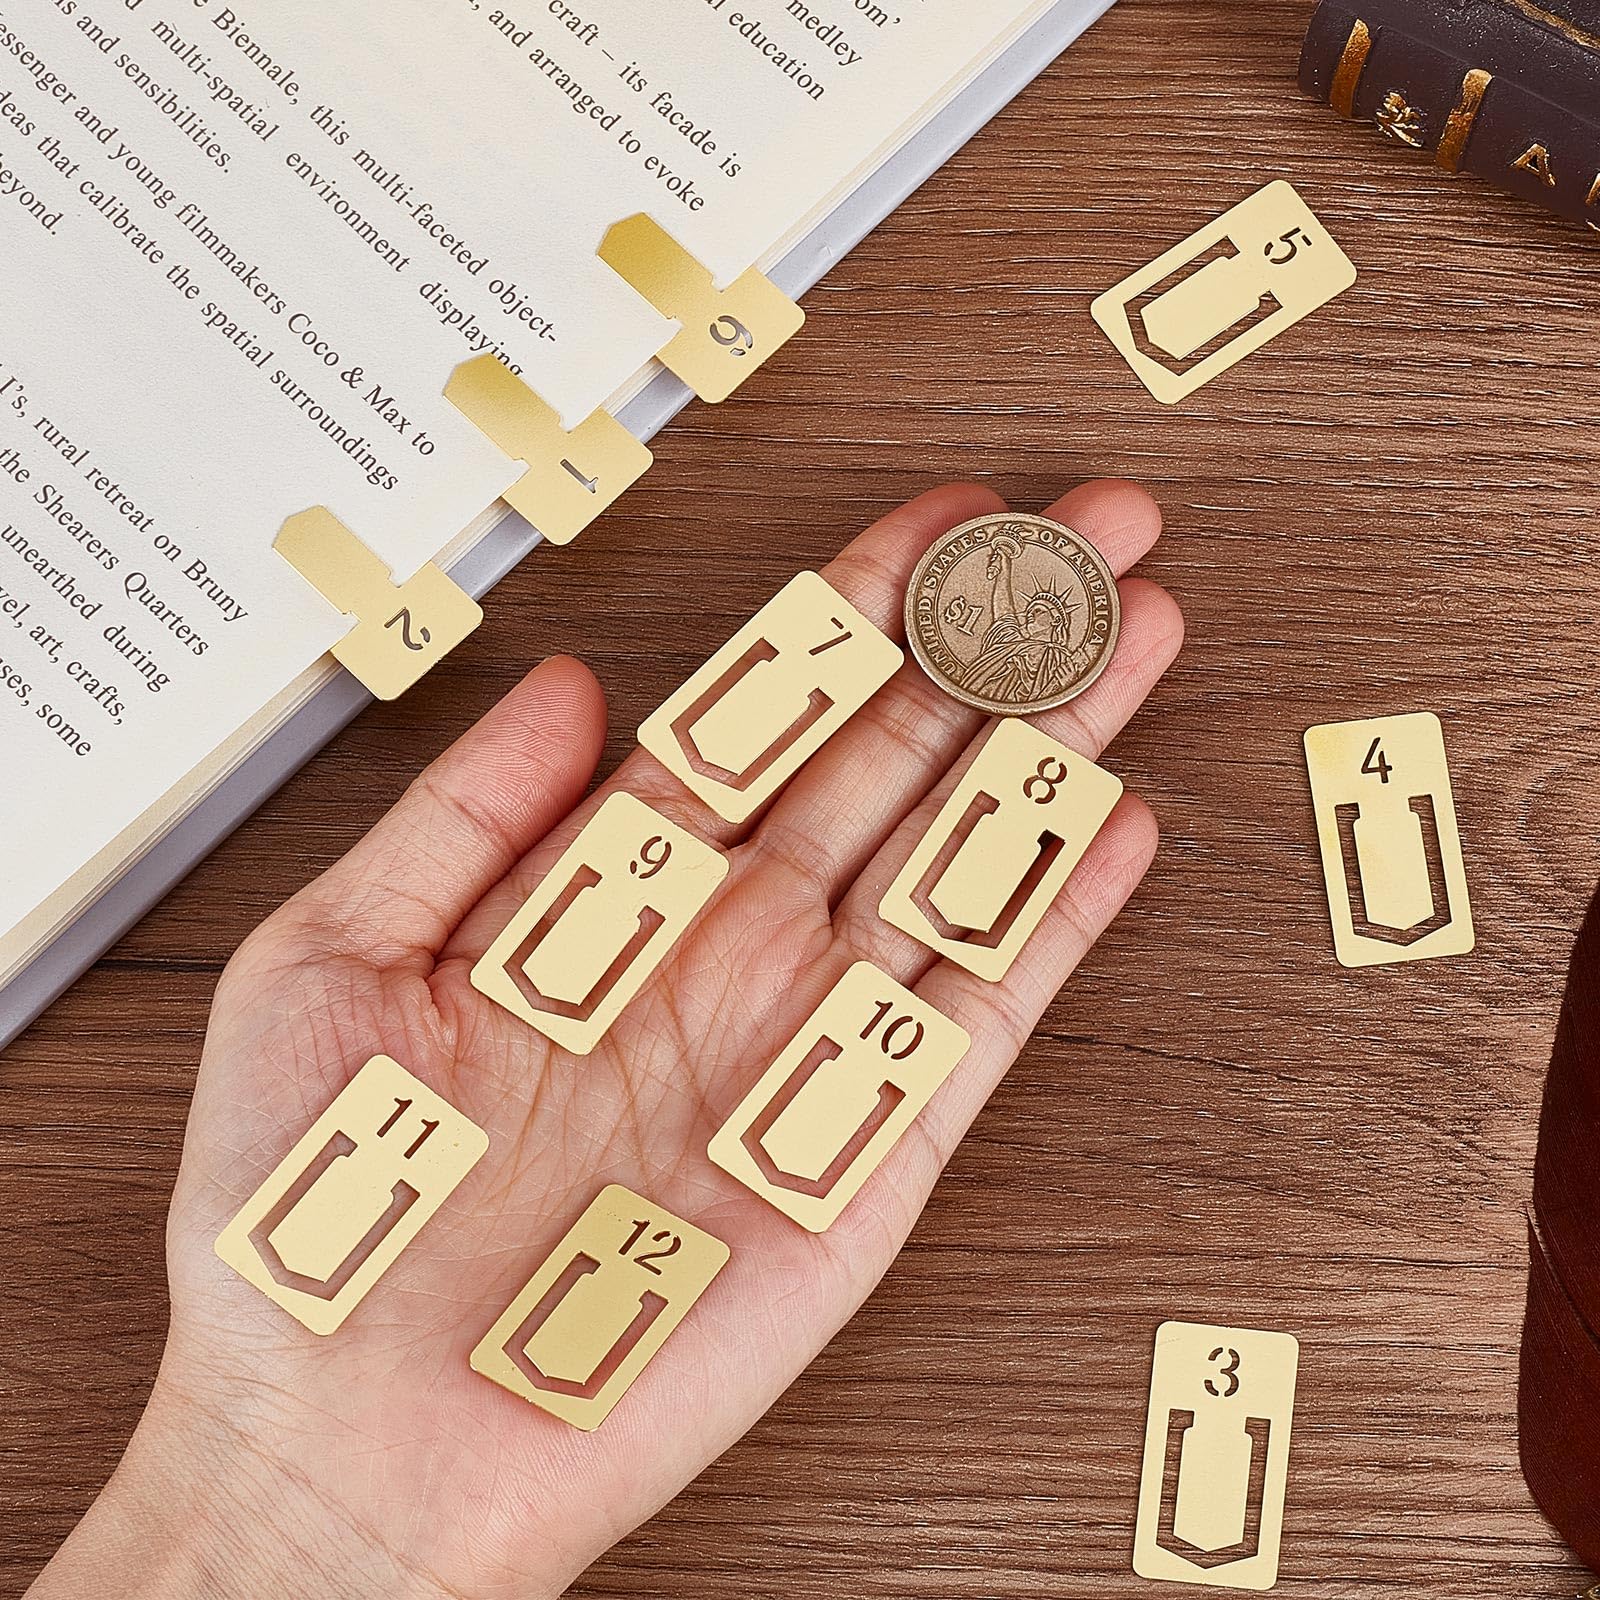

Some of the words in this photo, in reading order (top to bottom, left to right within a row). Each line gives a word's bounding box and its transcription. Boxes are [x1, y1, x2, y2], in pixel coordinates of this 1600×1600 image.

[729, 13, 824, 100] education
[786, 0, 862, 65] medley
[77, 16, 120, 53] and
[114, 54, 230, 173] sensibilities.
[489, 10, 533, 47] and
[529, 49, 621, 131] arranged
[619, 130, 640, 153] to
[645, 157, 704, 210] evoke
[548, 0, 599, 45] craft
[619, 62, 647, 92] its
[649, 92, 716, 154] facade
[719, 153, 741, 177] is
[151, 21, 279, 141] multi-spatial
[286, 154, 410, 272] environment
[212, 8, 300, 104] Biennale,
[310, 106, 349, 145] this
[352, 150, 489, 275] multi-faceted
[489, 280, 555, 341] object-
[1264, 227, 1312, 264] 5
[75, 107, 118, 144] and
[108, 143, 176, 208] young
[175, 204, 286, 314] filmmakers
[289, 314, 339, 366] Coco
[341, 367, 363, 388] &
[362, 384, 411, 434] Max
[412, 432, 434, 455] to
[38, 137, 79, 178] that
[80, 182, 163, 263] calibrate
[167, 265, 199, 299] the
[201, 303, 274, 368] spatial
[270, 370, 398, 489] surroundings
[560, 459, 598, 493] 1
[34, 417, 89, 467] rural
[84, 468, 154, 532] retreat
[154, 535, 181, 562] on
[182, 558, 248, 621] Bruny
[1037, 529, 1069, 549] OF
[33, 485, 119, 569] Shearers
[125, 573, 208, 655] Quarters
[923, 527, 988, 589] STATES
[1, 525, 103, 620] unearthed
[104, 626, 170, 692] during
[384, 607, 430, 650] 2
[944, 595, 984, 637] $1
[1071, 551, 1110, 646] AMERICA
[809, 617, 853, 656] 7
[917, 597, 956, 676] UNITED
[30, 626, 63, 663] art,
[67, 662, 125, 725] crafts,
[36, 704, 91, 755] some
[1361, 737, 1392, 783] 4
[1023, 757, 1067, 804] 8
[630, 836, 672, 879] 9
[859, 1001, 924, 1060] 10
[377, 1098, 439, 1159] 11
[618, 1220, 681, 1275] 12
[1204, 1347, 1240, 1397] 3
